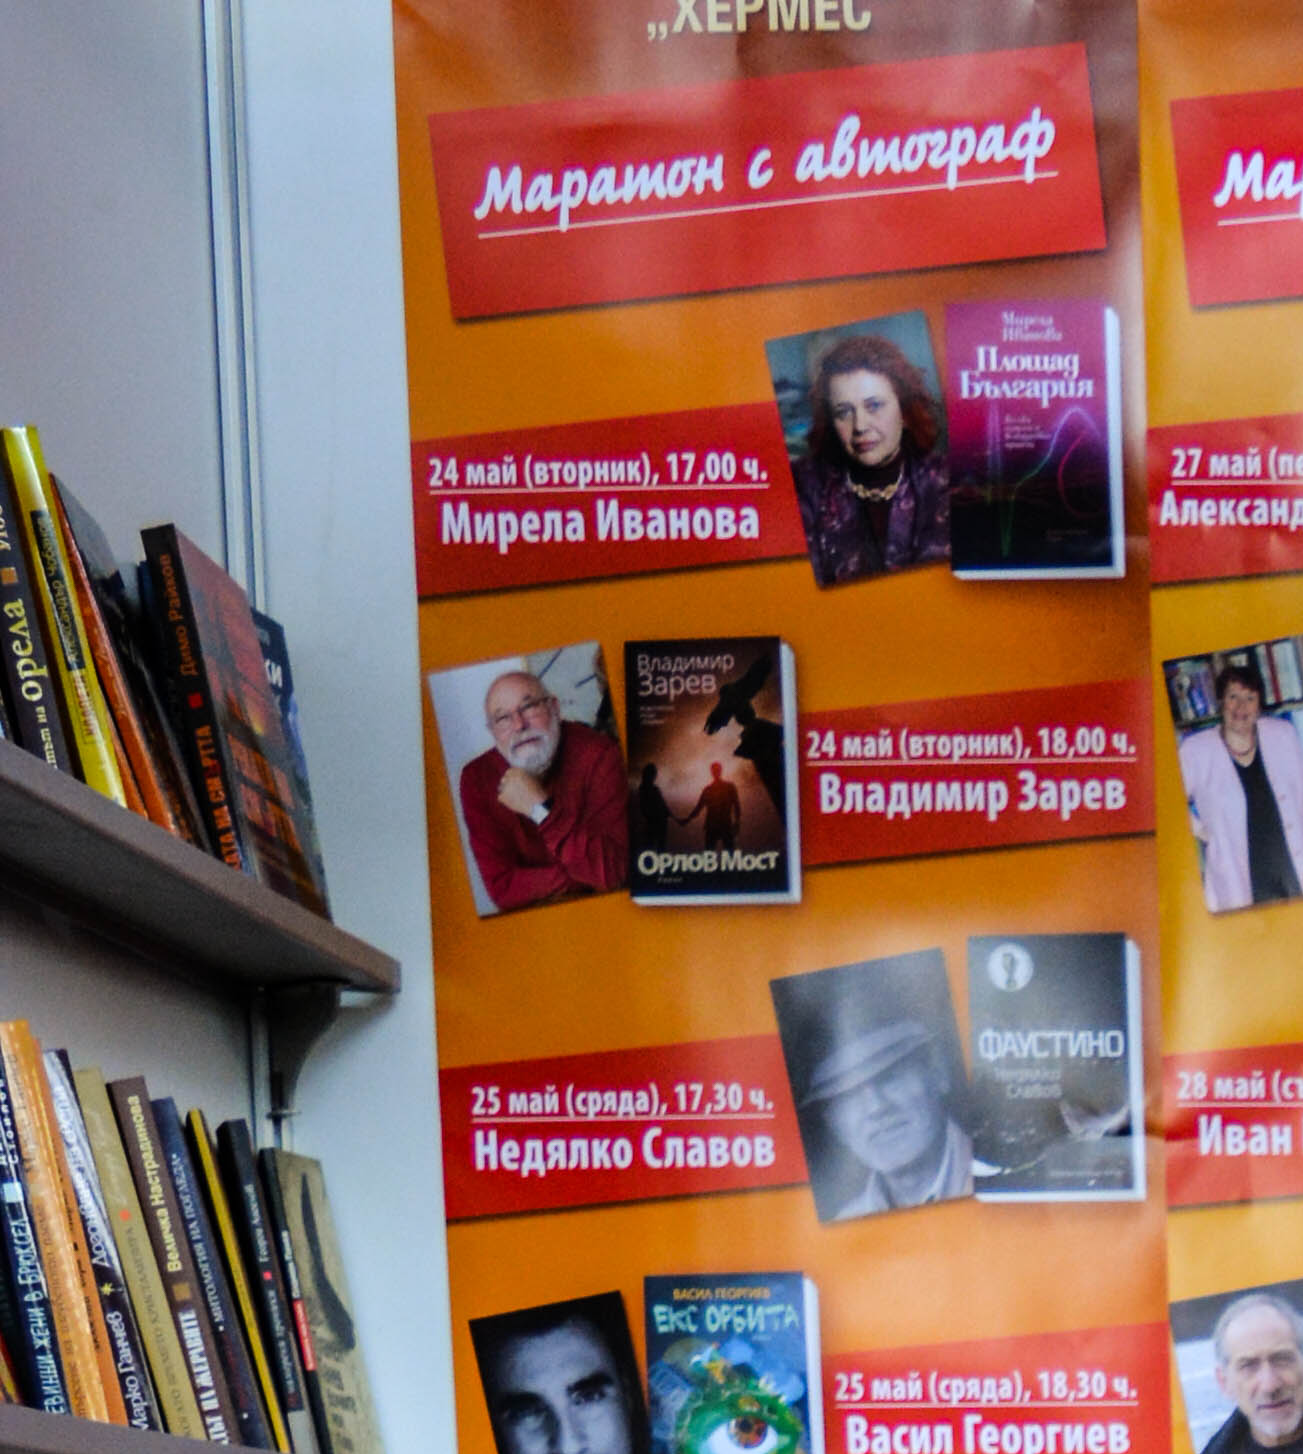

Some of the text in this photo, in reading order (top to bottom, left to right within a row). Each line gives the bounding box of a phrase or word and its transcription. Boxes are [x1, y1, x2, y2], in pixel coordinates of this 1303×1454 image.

[474, 106, 1057, 231] Маратон с автограф
[429, 451, 769, 491] 24 май (вторник), 17,00 ч.
[441, 500, 760, 553] Мирела Иванова
[3, 598, 49, 701] орела
[808, 729, 1136, 762] 24 май (вторник), 18,00 ч.
[819, 772, 1126, 818] Владимир Зарев
[472, 1084, 774, 1118] 25 май (сряда), 17,30 ч.
[125, 1094, 166, 1206] Настрадинова
[474, 1128, 775, 1176] Недялко Славов
[1199, 1116, 1292, 1155] Иван
[155, 1206, 184, 1272] Величка
[836, 1370, 1138, 1402] 25 май (сряда), 18,30 ч.
